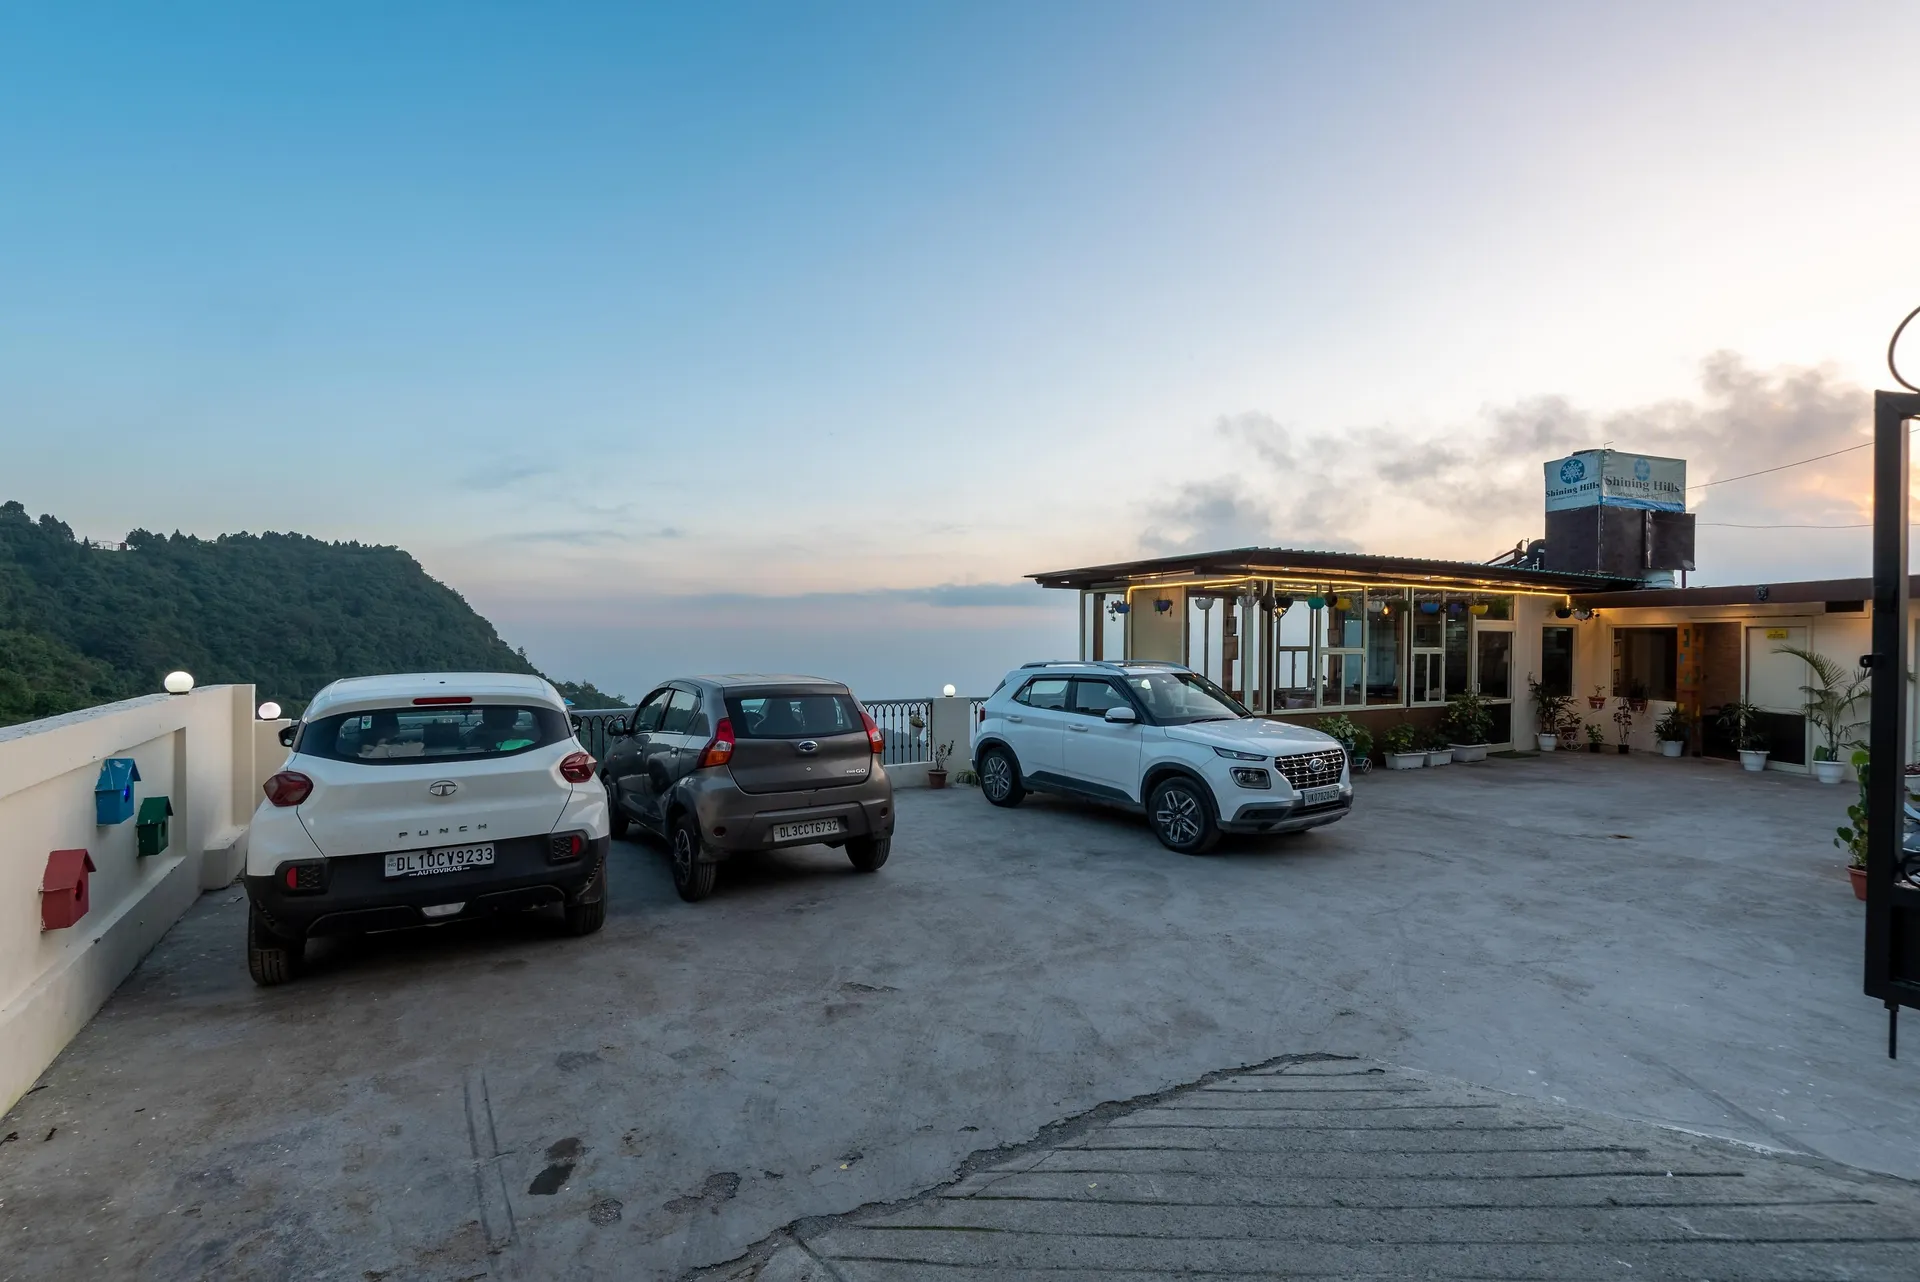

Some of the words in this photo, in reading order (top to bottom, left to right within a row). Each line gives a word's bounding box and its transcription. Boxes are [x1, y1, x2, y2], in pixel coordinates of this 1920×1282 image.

[1546, 487, 1578, 498] Shining
[1580, 481, 1600, 491] Hills
[1605, 475, 1650, 492] Shining
[1653, 480, 1680, 493] Hills
[399, 823, 487, 838] PUNCH
[780, 821, 838, 838] DL3CCT6732
[397, 847, 493, 871] DL10CV9233
